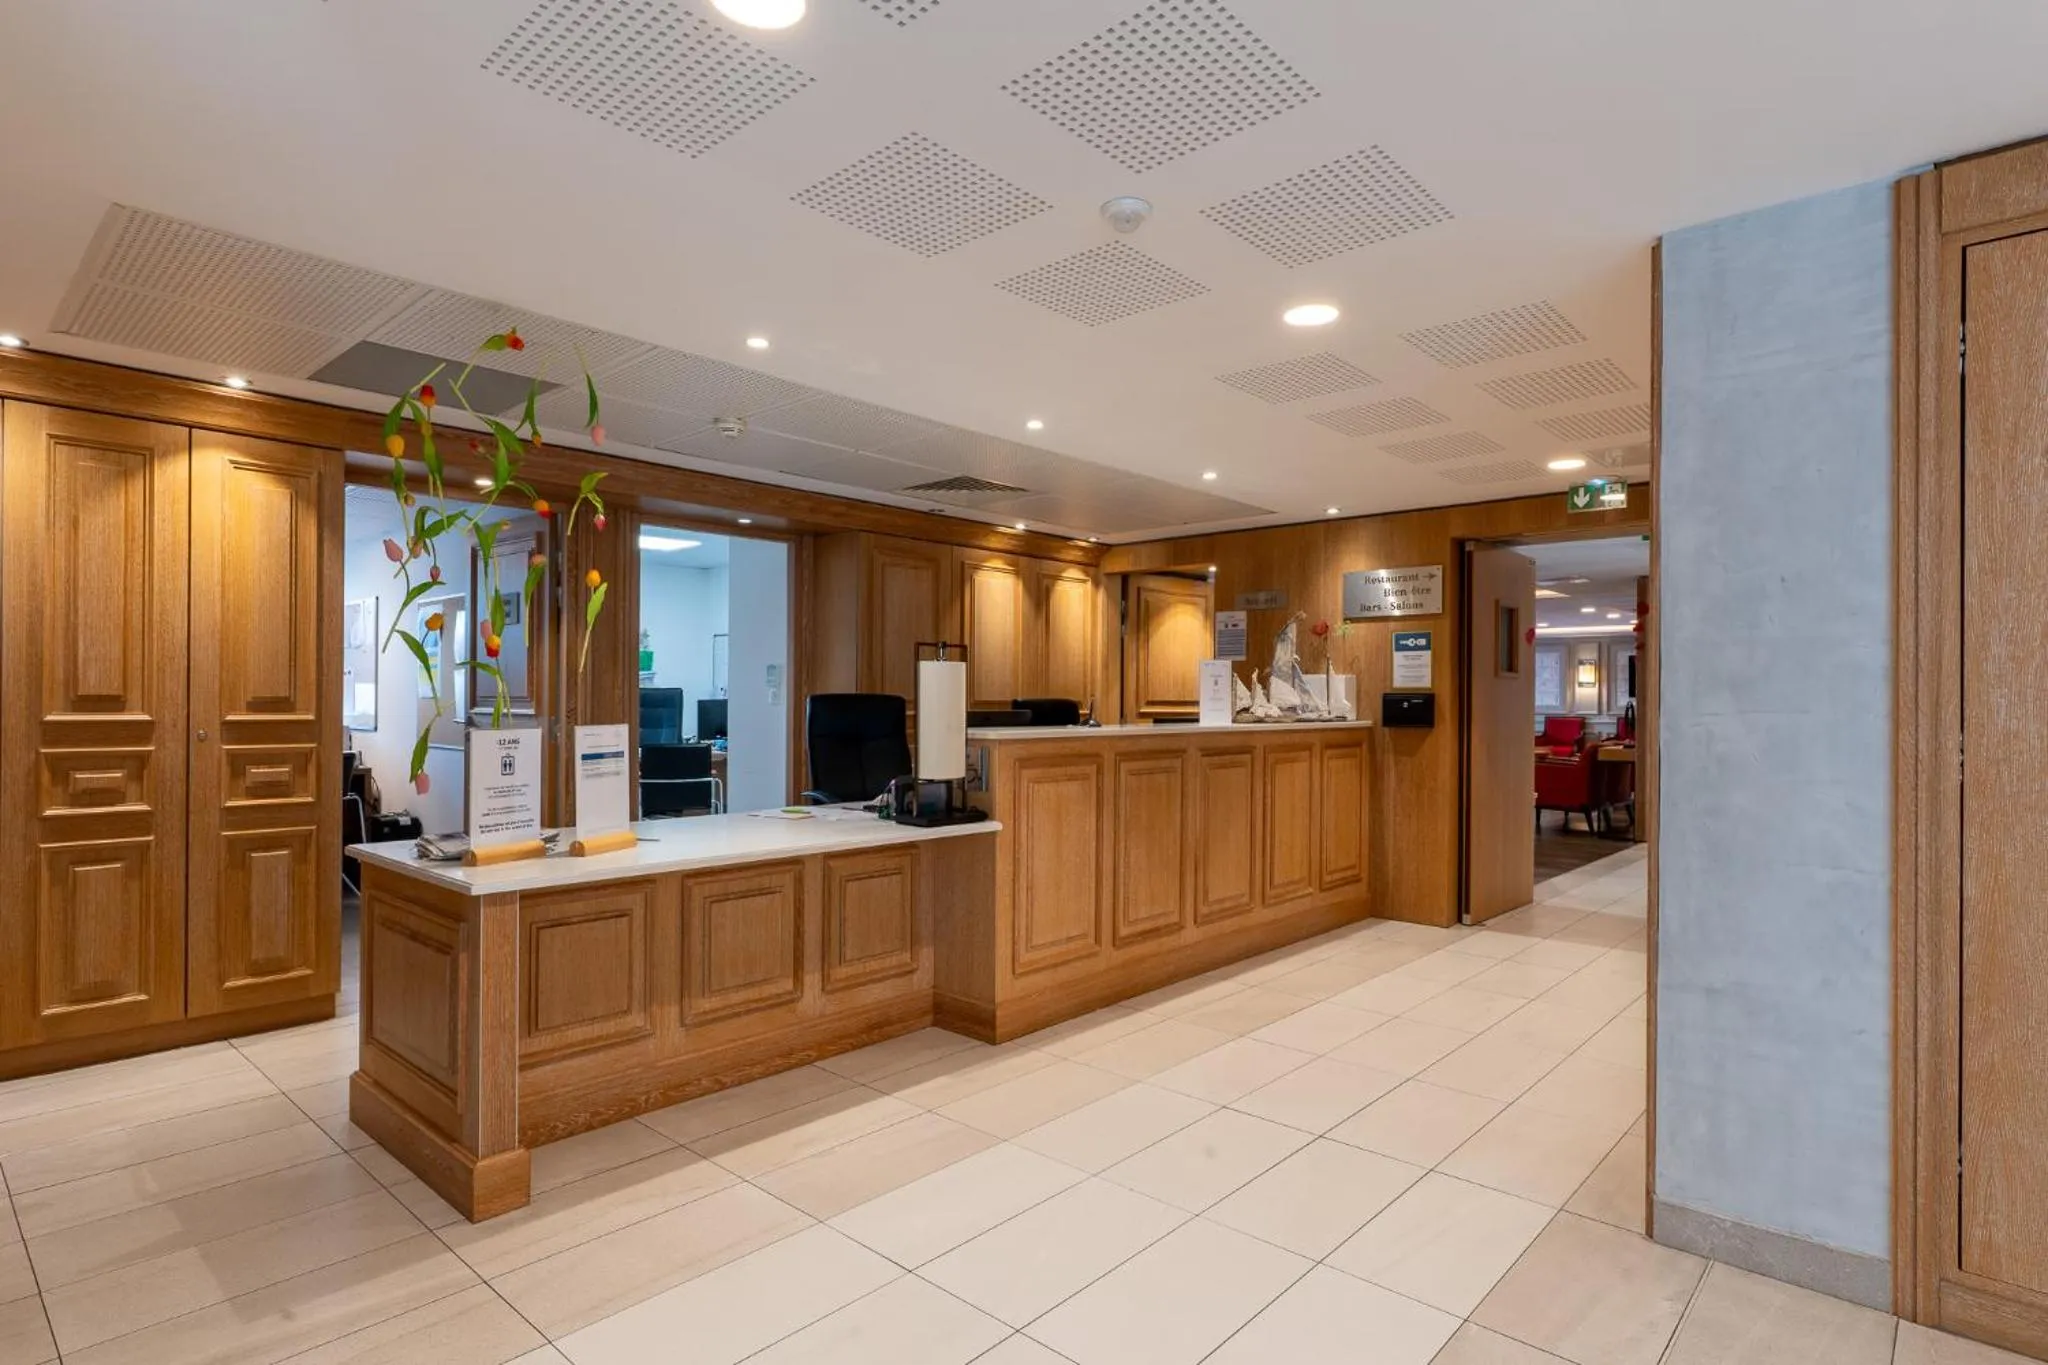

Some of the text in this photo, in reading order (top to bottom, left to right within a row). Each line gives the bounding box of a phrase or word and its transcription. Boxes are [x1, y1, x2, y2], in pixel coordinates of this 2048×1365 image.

[1364, 573, 1419, 585] Restaurant
[1383, 588, 1407, 597] Bien
[1360, 603, 1381, 613] Bars
[1389, 601, 1424, 611] Salons
